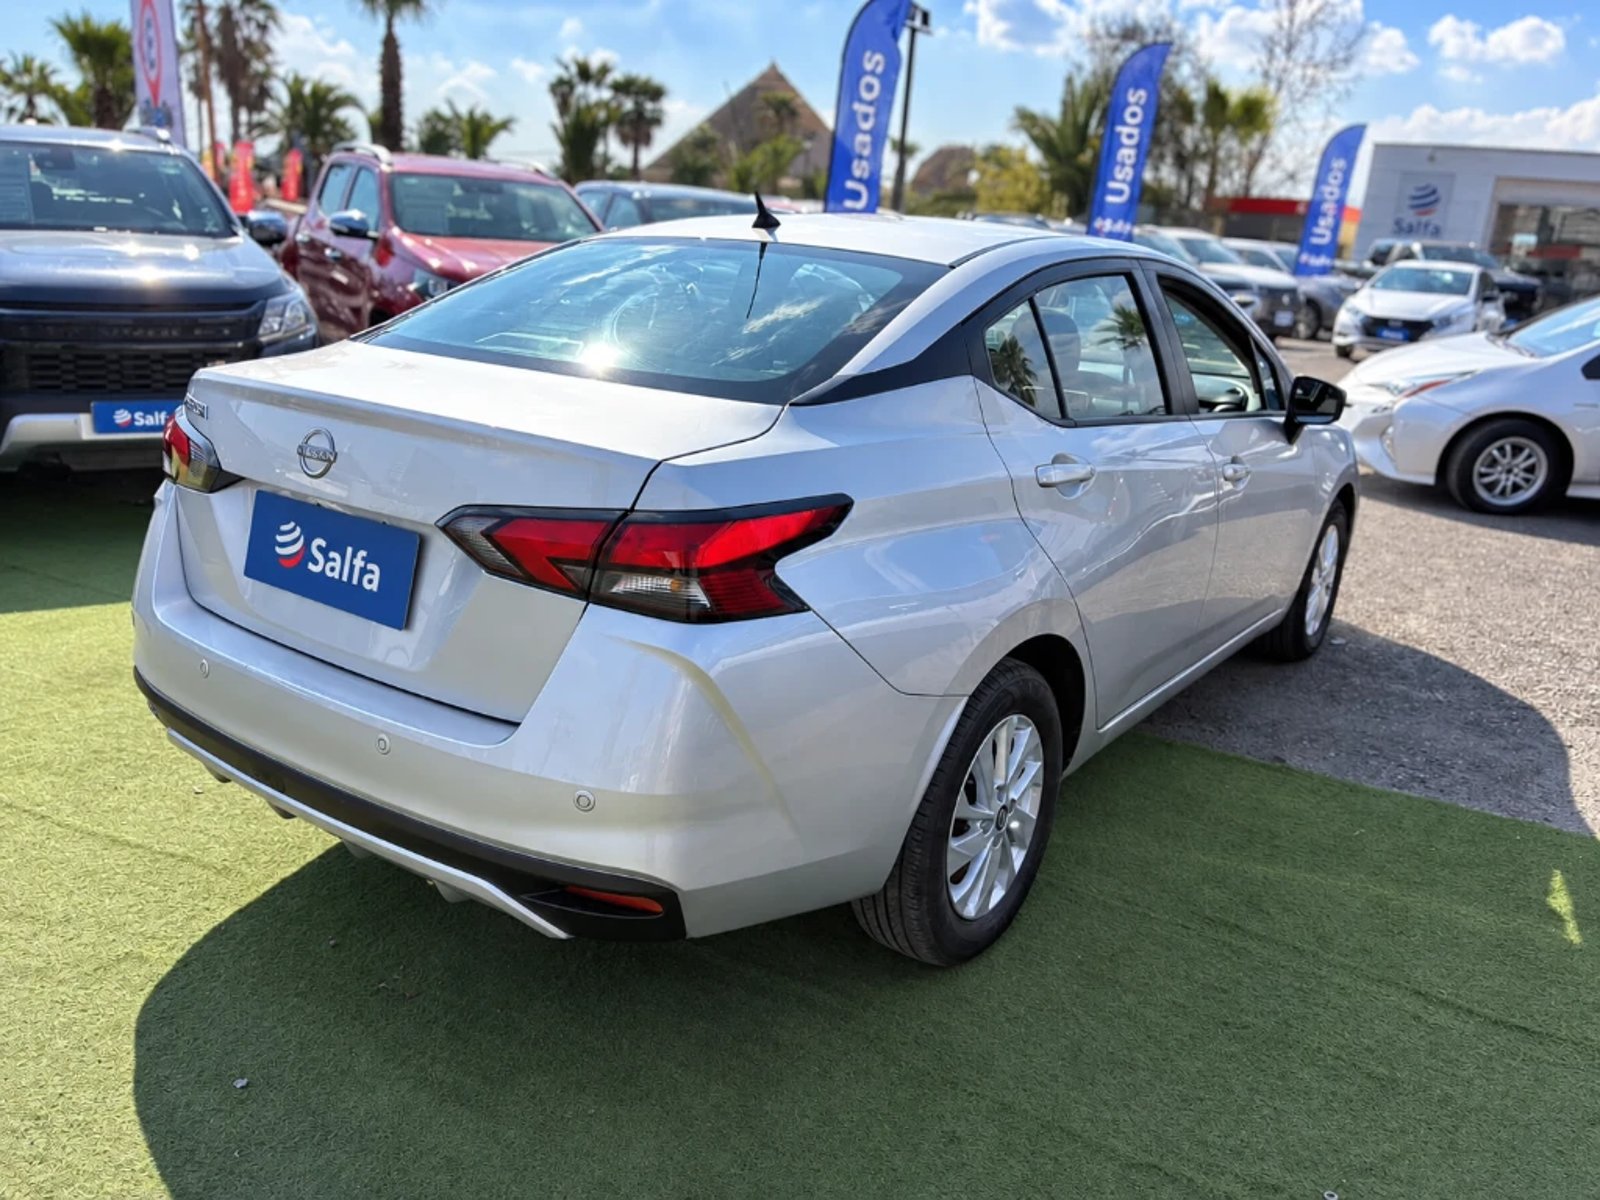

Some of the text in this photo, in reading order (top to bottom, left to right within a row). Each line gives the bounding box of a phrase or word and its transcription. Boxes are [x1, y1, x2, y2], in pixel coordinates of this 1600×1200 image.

[843, 50, 885, 210] Usados
[1104, 88, 1148, 203] Usados
[1309, 157, 1347, 245] Usados
[133, 410, 169, 427] Salf
[307, 537, 381, 592] Salfa
